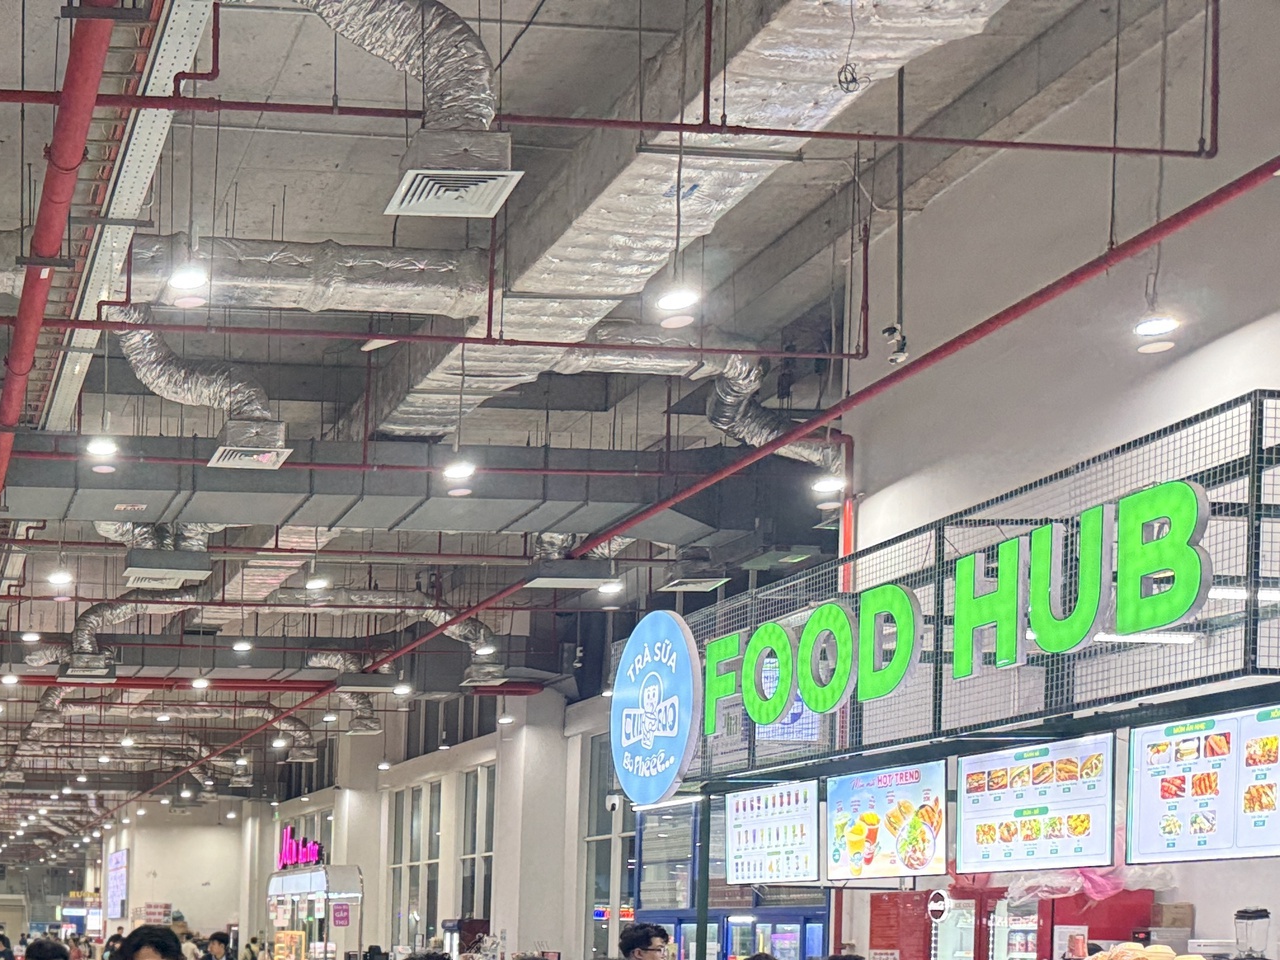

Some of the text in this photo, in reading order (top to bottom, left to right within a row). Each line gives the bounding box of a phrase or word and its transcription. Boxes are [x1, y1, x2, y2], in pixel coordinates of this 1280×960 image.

[704, 480, 1205, 737] FOOD HUB
[627, 639, 677, 683] TRÀ SỮA
[877, 773, 892, 786] HOT
[895, 769, 920, 782] TREND
